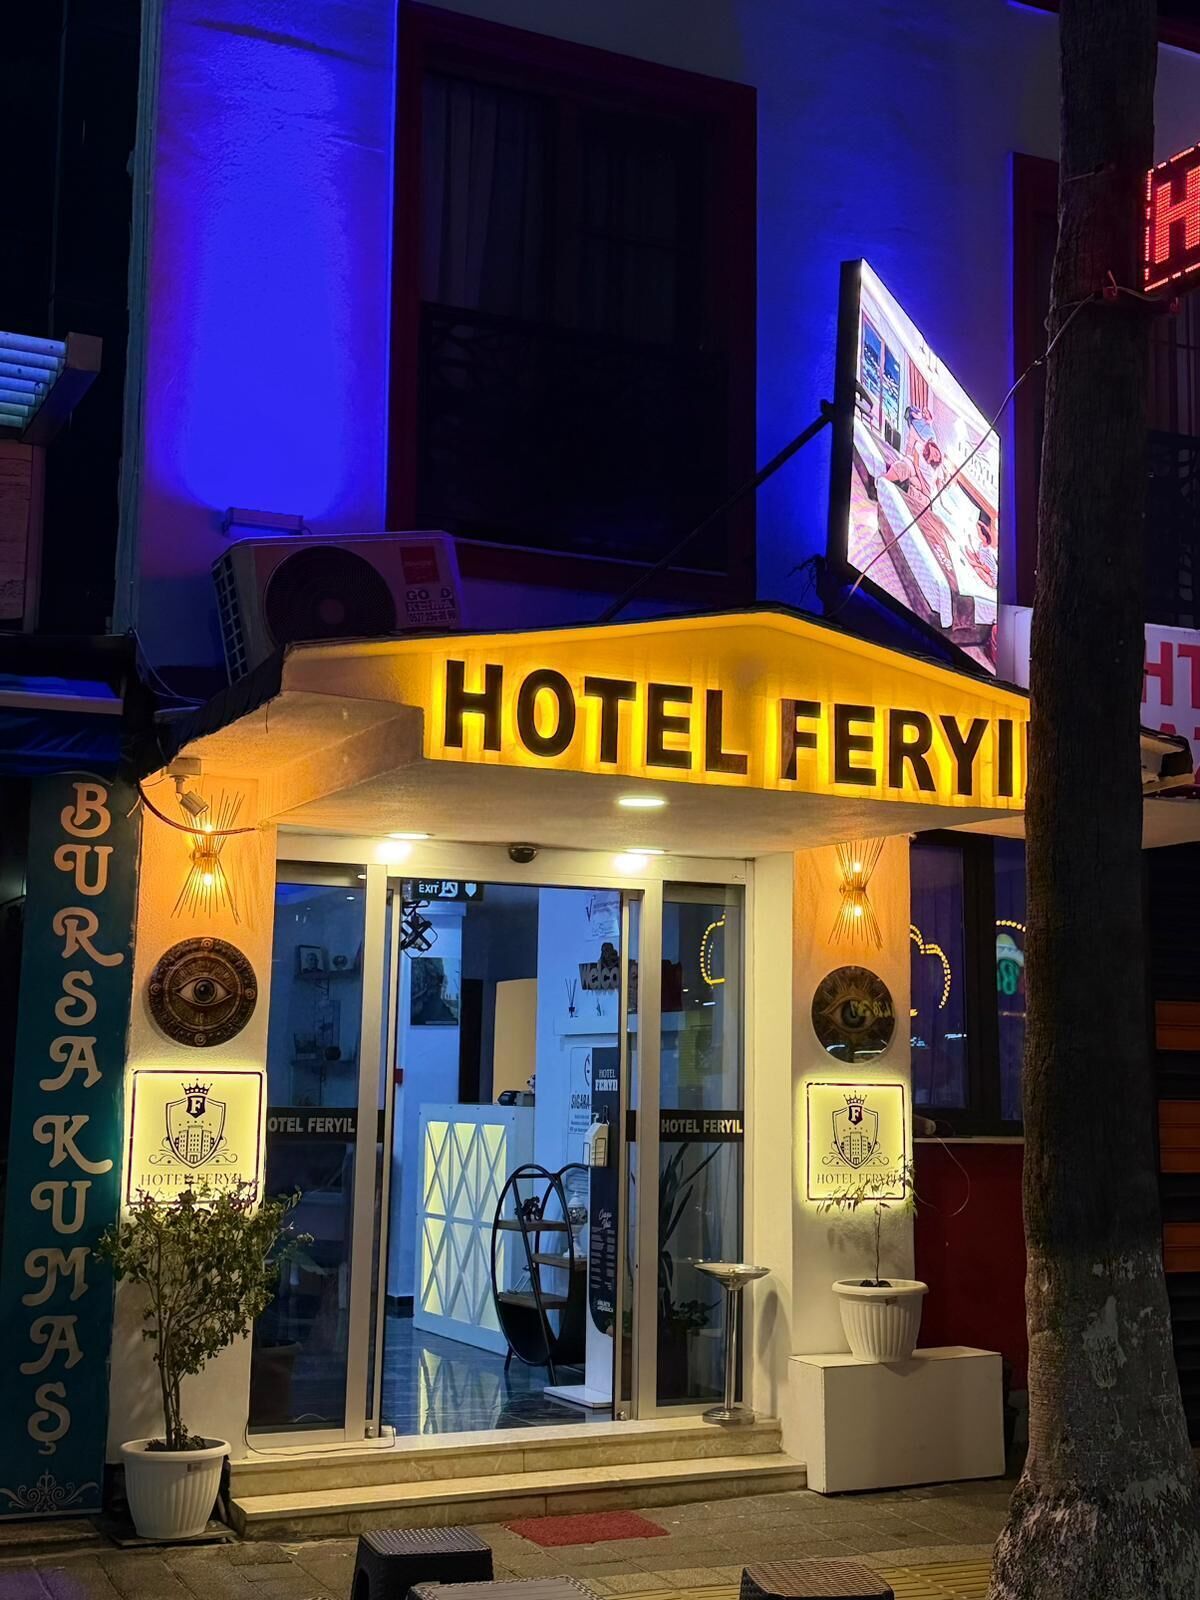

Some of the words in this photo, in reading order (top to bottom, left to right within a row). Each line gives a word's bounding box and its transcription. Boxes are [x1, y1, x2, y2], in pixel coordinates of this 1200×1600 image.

[445, 660, 747, 773] HOTEL
[781, 698, 1029, 797] FERYI
[418, 883, 440, 894] EXIT
[39, 783, 123, 1090] BURSA
[598, 1069, 616, 1079] HOTEL
[307, 1116, 356, 1135] FERYIL
[660, 1119, 701, 1134] HOTEL
[703, 1119, 743, 1134] FERYIL
[816, 1172, 854, 1185] HOTEL
[20, 1113, 113, 1456] KUMAŞ
